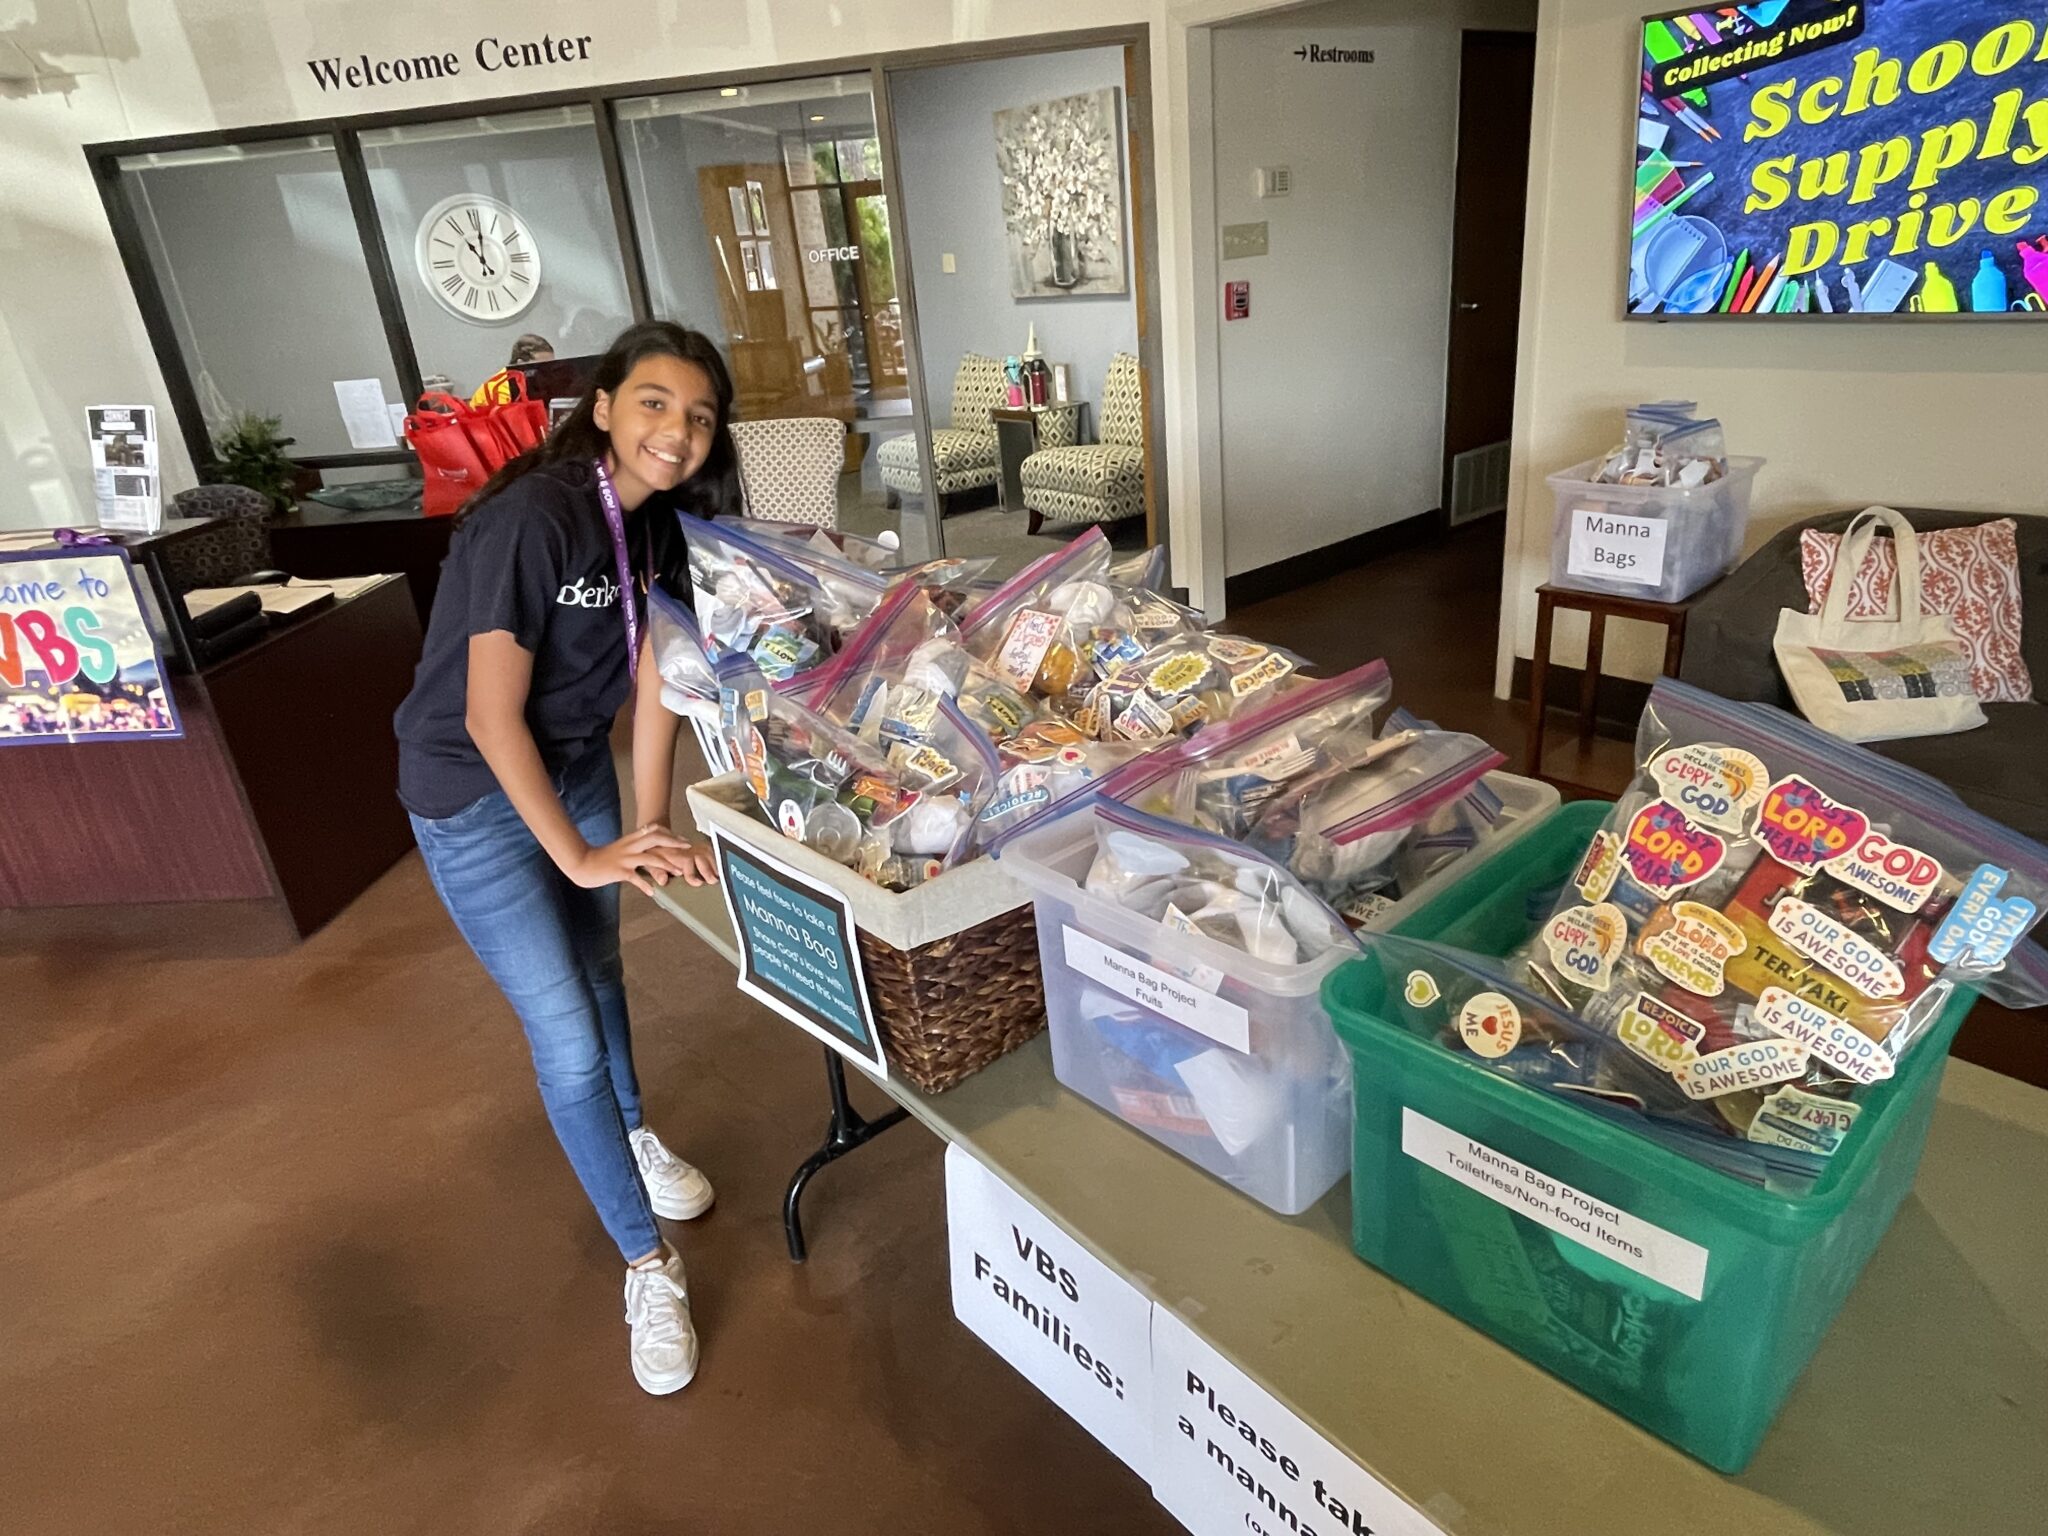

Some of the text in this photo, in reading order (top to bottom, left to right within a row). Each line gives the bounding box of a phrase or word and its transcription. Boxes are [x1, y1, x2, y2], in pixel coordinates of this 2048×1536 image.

[306, 34, 592, 93] Welcome Center
[1310, 44, 1375, 63] Restrooms
[1664, 5, 1857, 87] Collecting Now!
[808, 245, 860, 263] OFFICE
[1780, 186, 2039, 277] Drive
[1585, 515, 1650, 538] Manna
[78, 567, 109, 600] to
[1593, 547, 1637, 569] Bags
[1665, 757, 1714, 788] GLORY
[1680, 785, 1729, 816] GOD
[1764, 793, 1847, 850] LORD
[1631, 815, 1704, 875] LORD
[1857, 835, 1939, 887] GOD
[730, 863, 756, 889] Please
[791, 901, 803, 917] to
[803, 908, 826, 930] take
[827, 924, 836, 936] a
[1844, 861, 1920, 907] AWESOME
[743, 893, 838, 970] Manna Bag
[1553, 920, 1590, 948] GLORY
[1937, 871, 2001, 955] EVERY DAY
[1968, 906, 2002, 943] GOD
[1565, 947, 1600, 976] GOD
[1676, 919, 1728, 960] LORD
[1775, 916, 1886, 998] IS AWESOME
[1801, 912, 1884, 974] OUR GOD
[1103, 955, 1197, 1009] Manna Bag Project
[1650, 944, 1716, 993] FOREVER
[1135, 987, 1164, 1009] Fruits
[1642, 1000, 1696, 1037] REJOICE
[1465, 1011, 1479, 1037] ME
[1495, 1002, 1516, 1053] JESUS
[1763, 1006, 1877, 1082] IS AWESOME
[1787, 1001, 1873, 1058] OUR GOD
[1687, 1057, 1803, 1095] IS AWESOME
[1693, 1045, 1779, 1076] OUR GOD
[1446, 1150, 1644, 1259] Toiletries/Non-food Items
[1468, 1141, 1620, 1226] Manna Bag Project
[1011, 1223, 1080, 1304] VBS
[973, 1250, 1125, 1400] Families:
[1177, 1413, 1196, 1441] a
[1186, 1369, 1301, 1482] Please
